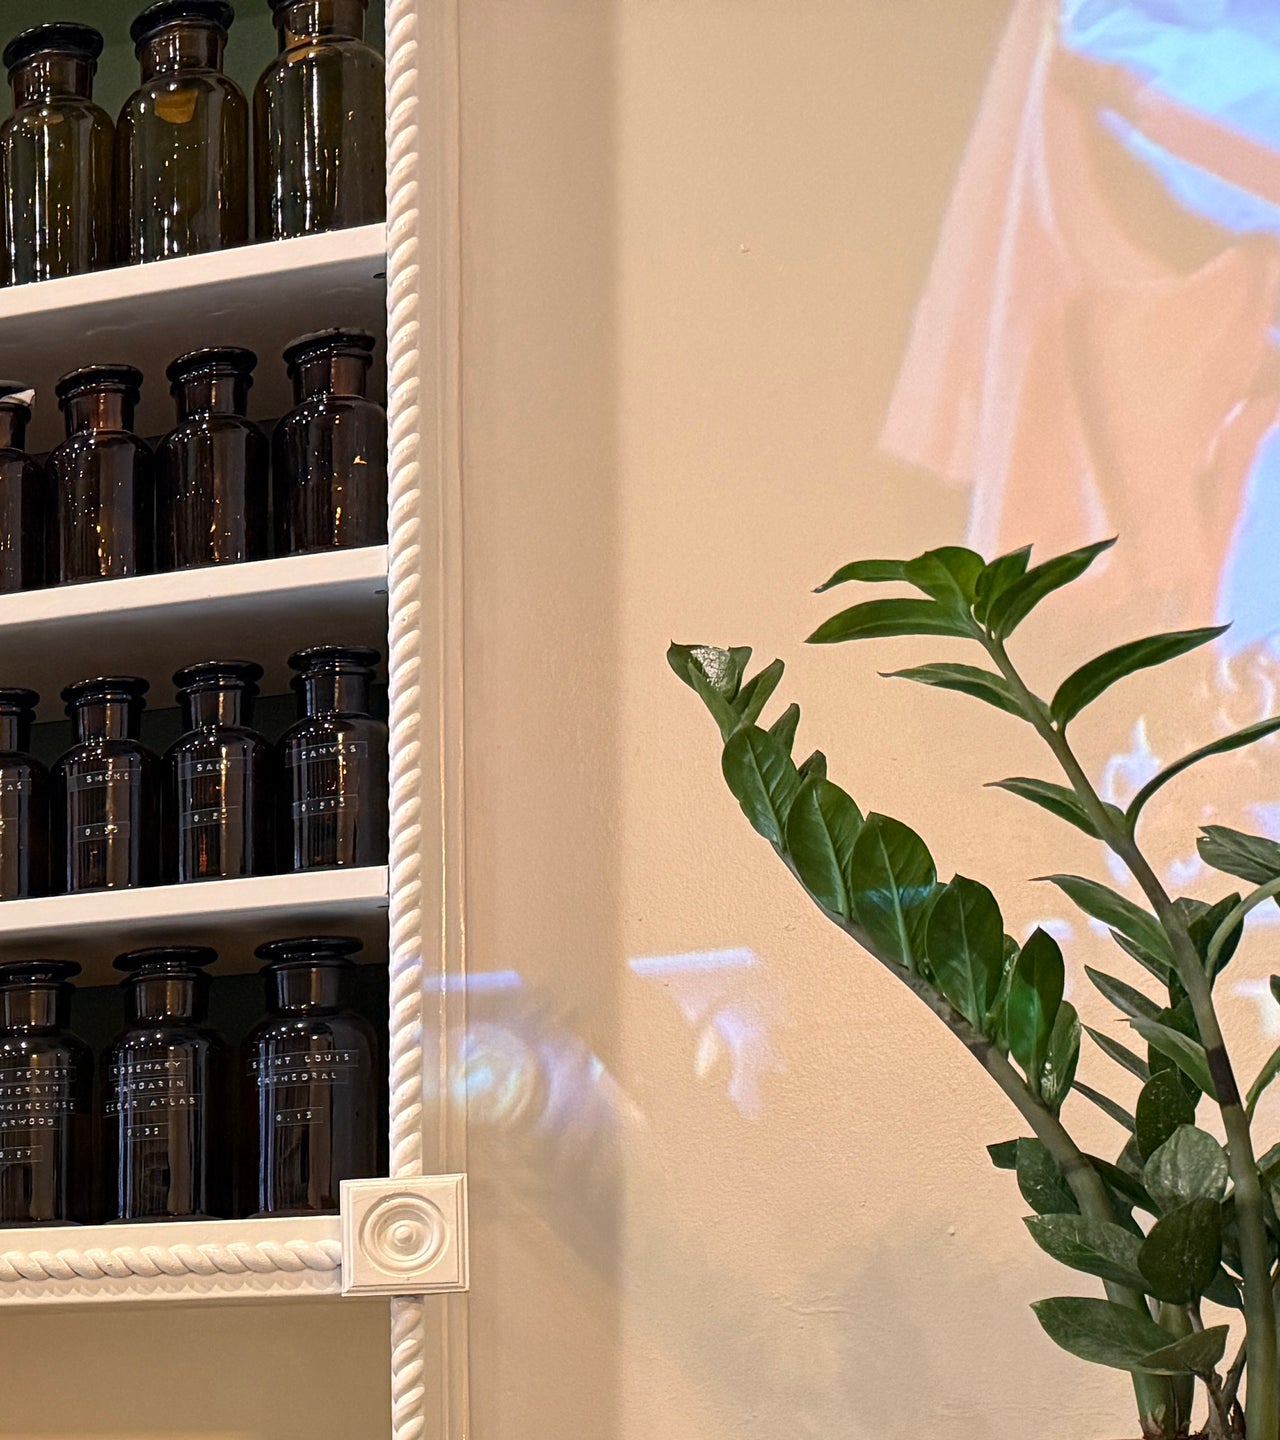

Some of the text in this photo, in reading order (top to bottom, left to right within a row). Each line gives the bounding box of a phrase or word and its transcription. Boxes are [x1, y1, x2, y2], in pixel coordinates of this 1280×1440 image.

[301, 744, 357, 760] CANVAS
[85, 772, 129, 783] SMOKE
[112, 1061, 181, 1075] ROSEMARY
[251, 1053, 349, 1070] SAINT LOUIS
[16, 1069, 68, 1079] PEPPER
[257, 1072, 336, 1086] CATHEDRAL
[115, 1080, 184, 1094] MANDARIN
[105, 1097, 196, 1113] CEDAR ATLAS
